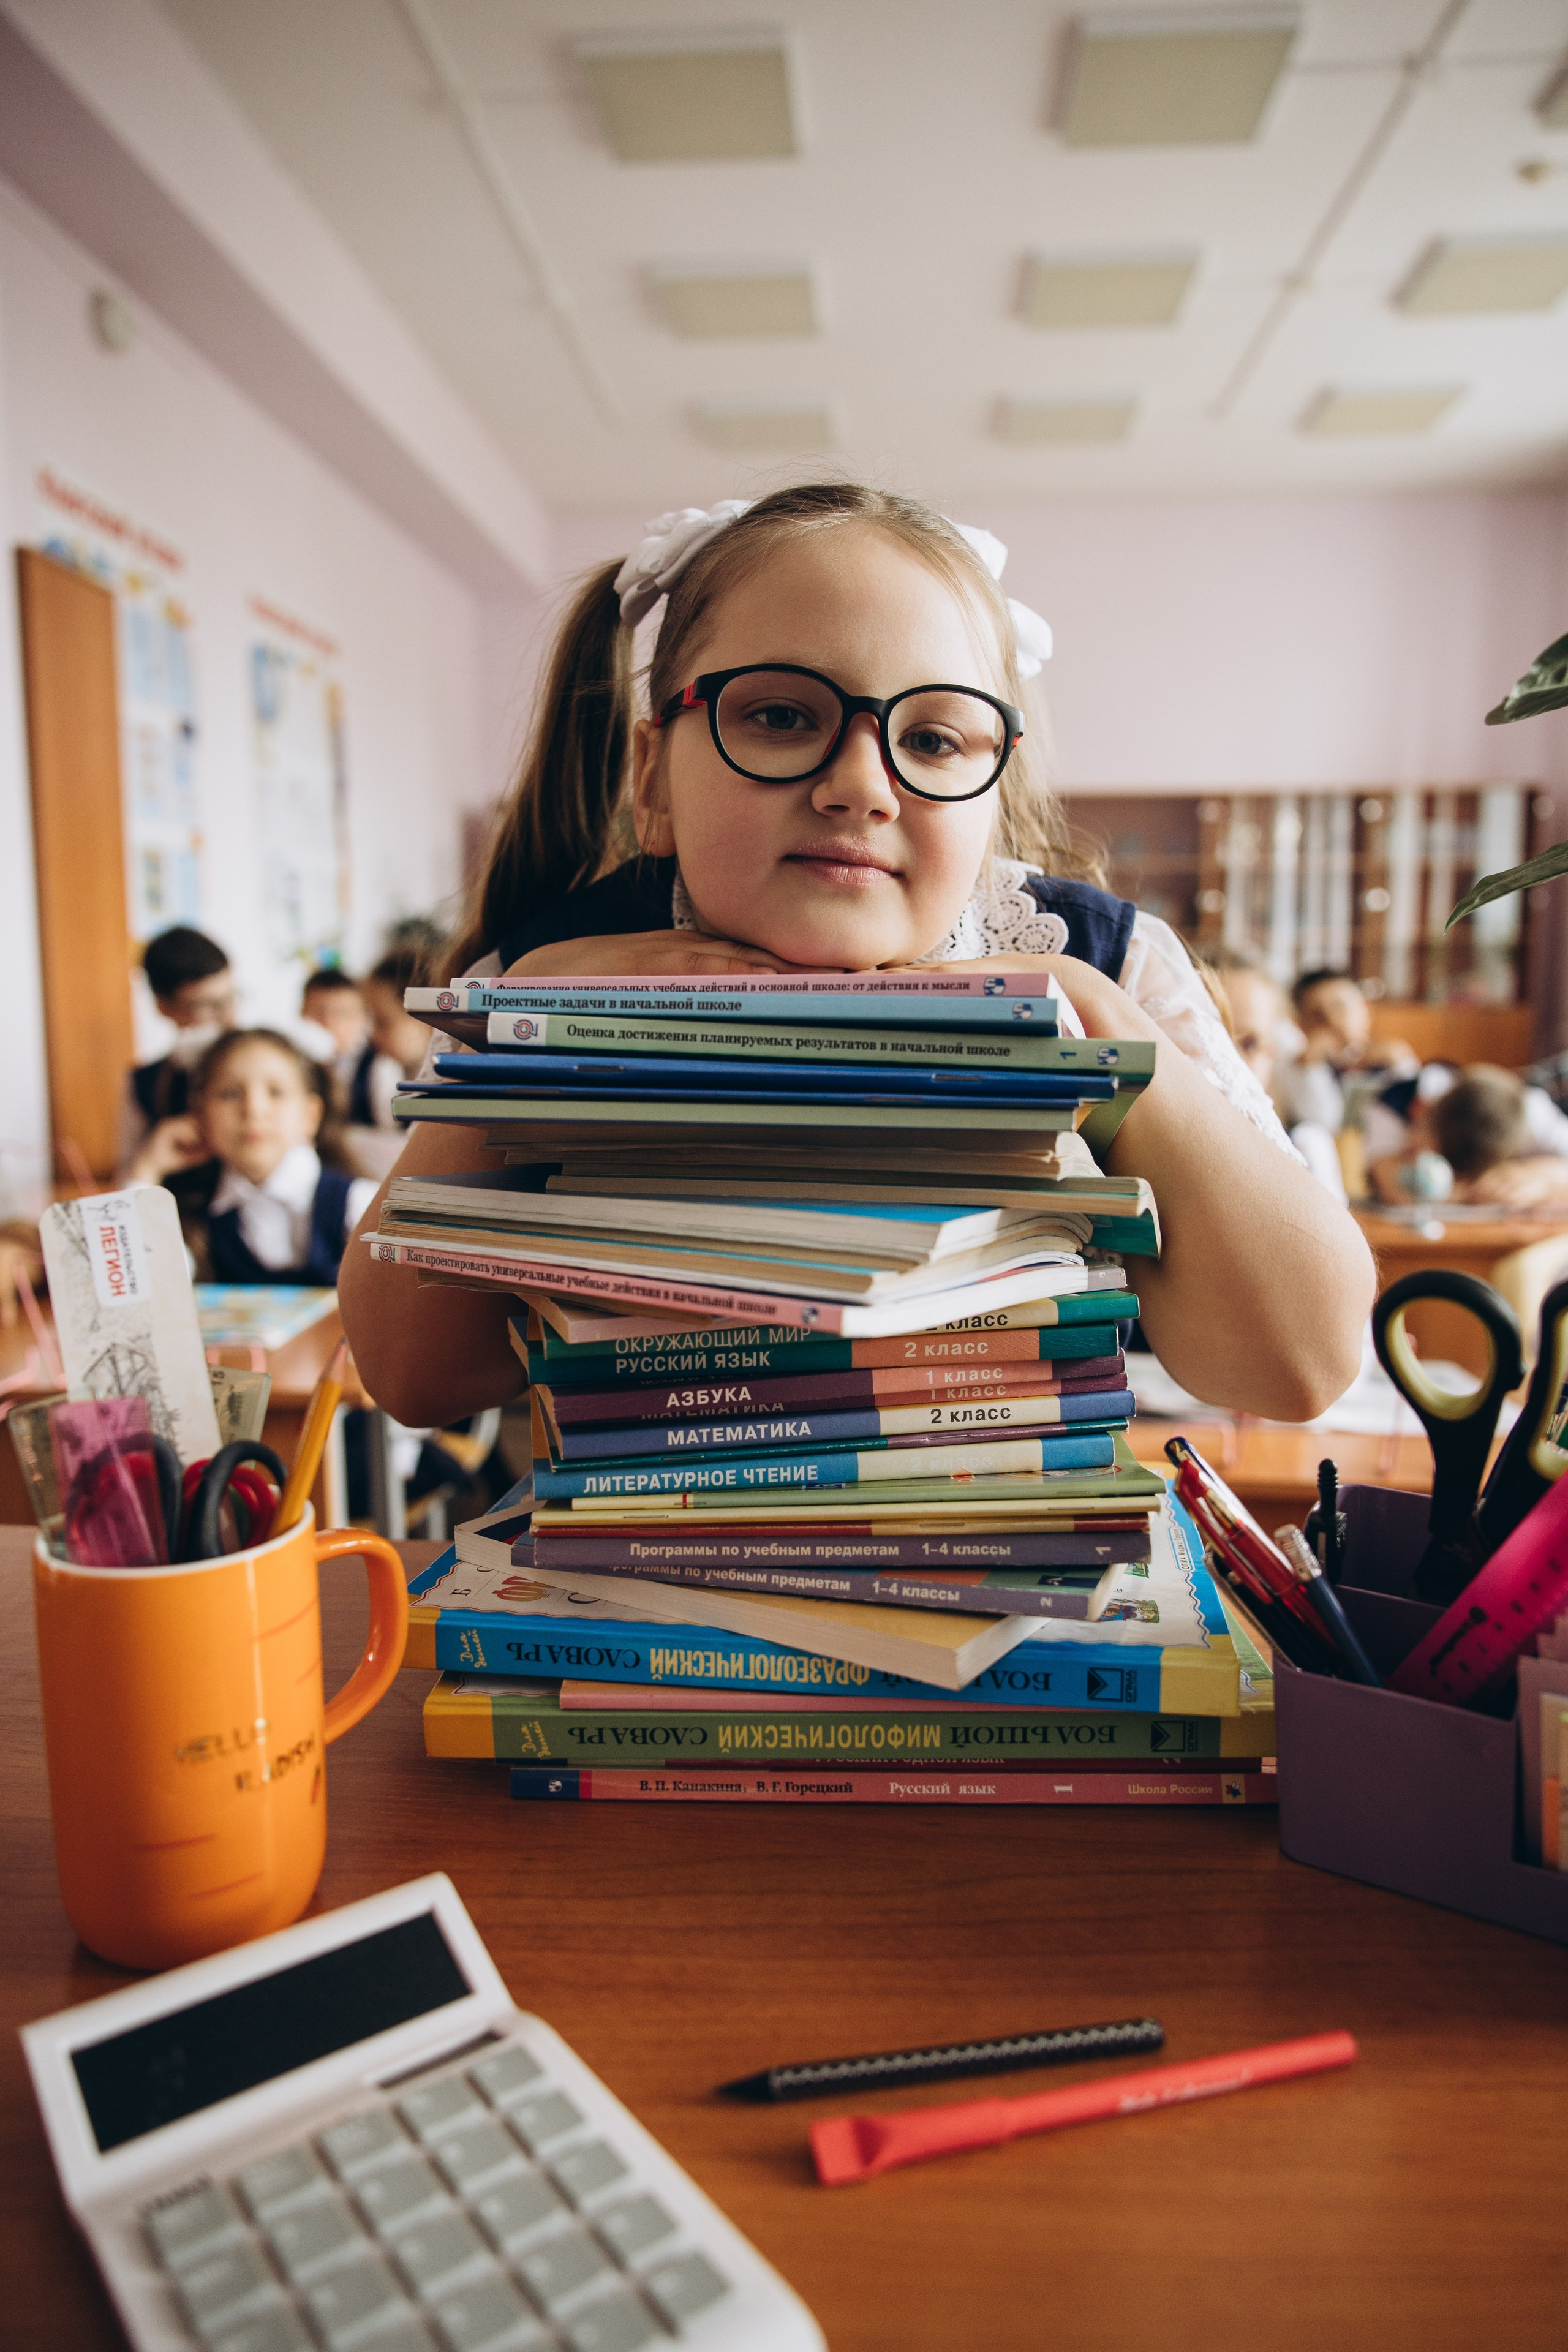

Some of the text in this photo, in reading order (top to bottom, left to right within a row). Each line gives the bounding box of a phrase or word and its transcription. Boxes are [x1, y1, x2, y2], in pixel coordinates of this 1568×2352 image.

[652, 983, 696, 993] учебных
[698, 981, 747, 993] действий
[759, 981, 809, 992] основной
[812, 982, 850, 991] школе:
[853, 982, 864, 991] от
[866, 980, 919, 992] действия
[921, 982, 929, 990] к
[931, 981, 971, 990] мысли
[481, 993, 742, 1013] Проектные задачи в начальной школе
[567, 1023, 1011, 1057] Оценка достижения планируемых результатов в начальной школе
[1060, 1050, 1077, 1060] 1
[99, 1226, 128, 1297] ЛЕГИОН
[407, 1249, 424, 1263] Как
[425, 1255, 491, 1274] проектировать
[491, 1264, 565, 1285] универсальные
[567, 1273, 611, 1291] учебные
[612, 1281, 662, 1300] действия
[673, 1291, 734, 1309] начальной
[615, 1325, 812, 1354] ОКРУЖАЮЩИЙ МИР
[905, 1341, 989, 1358] 2 класс
[616, 1350, 771, 1374] РУССКИЙ ЯЗЫК
[925, 1367, 1003, 1384] 1 класс
[666, 1385, 752, 1408] АЗБУКА
[929, 1385, 1007, 1400] 1 класс
[930, 1407, 1011, 1424] 2 класс
[666, 1421, 812, 1446] МАТЕМАТИКА
[583, 1464, 818, 1494] ЛИТЕРАТУРНОЕ ЧТЕНИЕ
[630, 1543, 899, 1558] Программы по учебным предметам
[952, 1544, 1011, 1556] классы
[1095, 1545, 1112, 1556] 1
[1177, 1542, 1186, 1556] Медиа
[1180, 1557, 1189, 1569] ОЛМА
[685, 1567, 701, 1577] по
[704, 1567, 767, 1584] учебным
[771, 1574, 851, 1592] предметам
[902, 1585, 961, 1602] классы
[1040, 1596, 1053, 1608] 2
[505, 1642, 641, 1668] СЛОВАРЬ
[649, 1647, 870, 1686] ФРАЗЕОЛОГИЧЕСКИЙ
[567, 1724, 1118, 1754] БОЛЬШОЙ МИФОЛОГИЧЕСКИЙ СЛОВАРЬ
[639, 1780, 652, 1792] В.
[672, 1780, 747, 1793] Канакина,
[755, 1781, 769, 1792] В.
[772, 1781, 782, 1793] Г.
[785, 1781, 853, 1796] Горецкий
[889, 1782, 996, 1797] Русский язык
[1054, 1783, 1073, 1794] 1
[1128, 1784, 1213, 1795] Школа России
